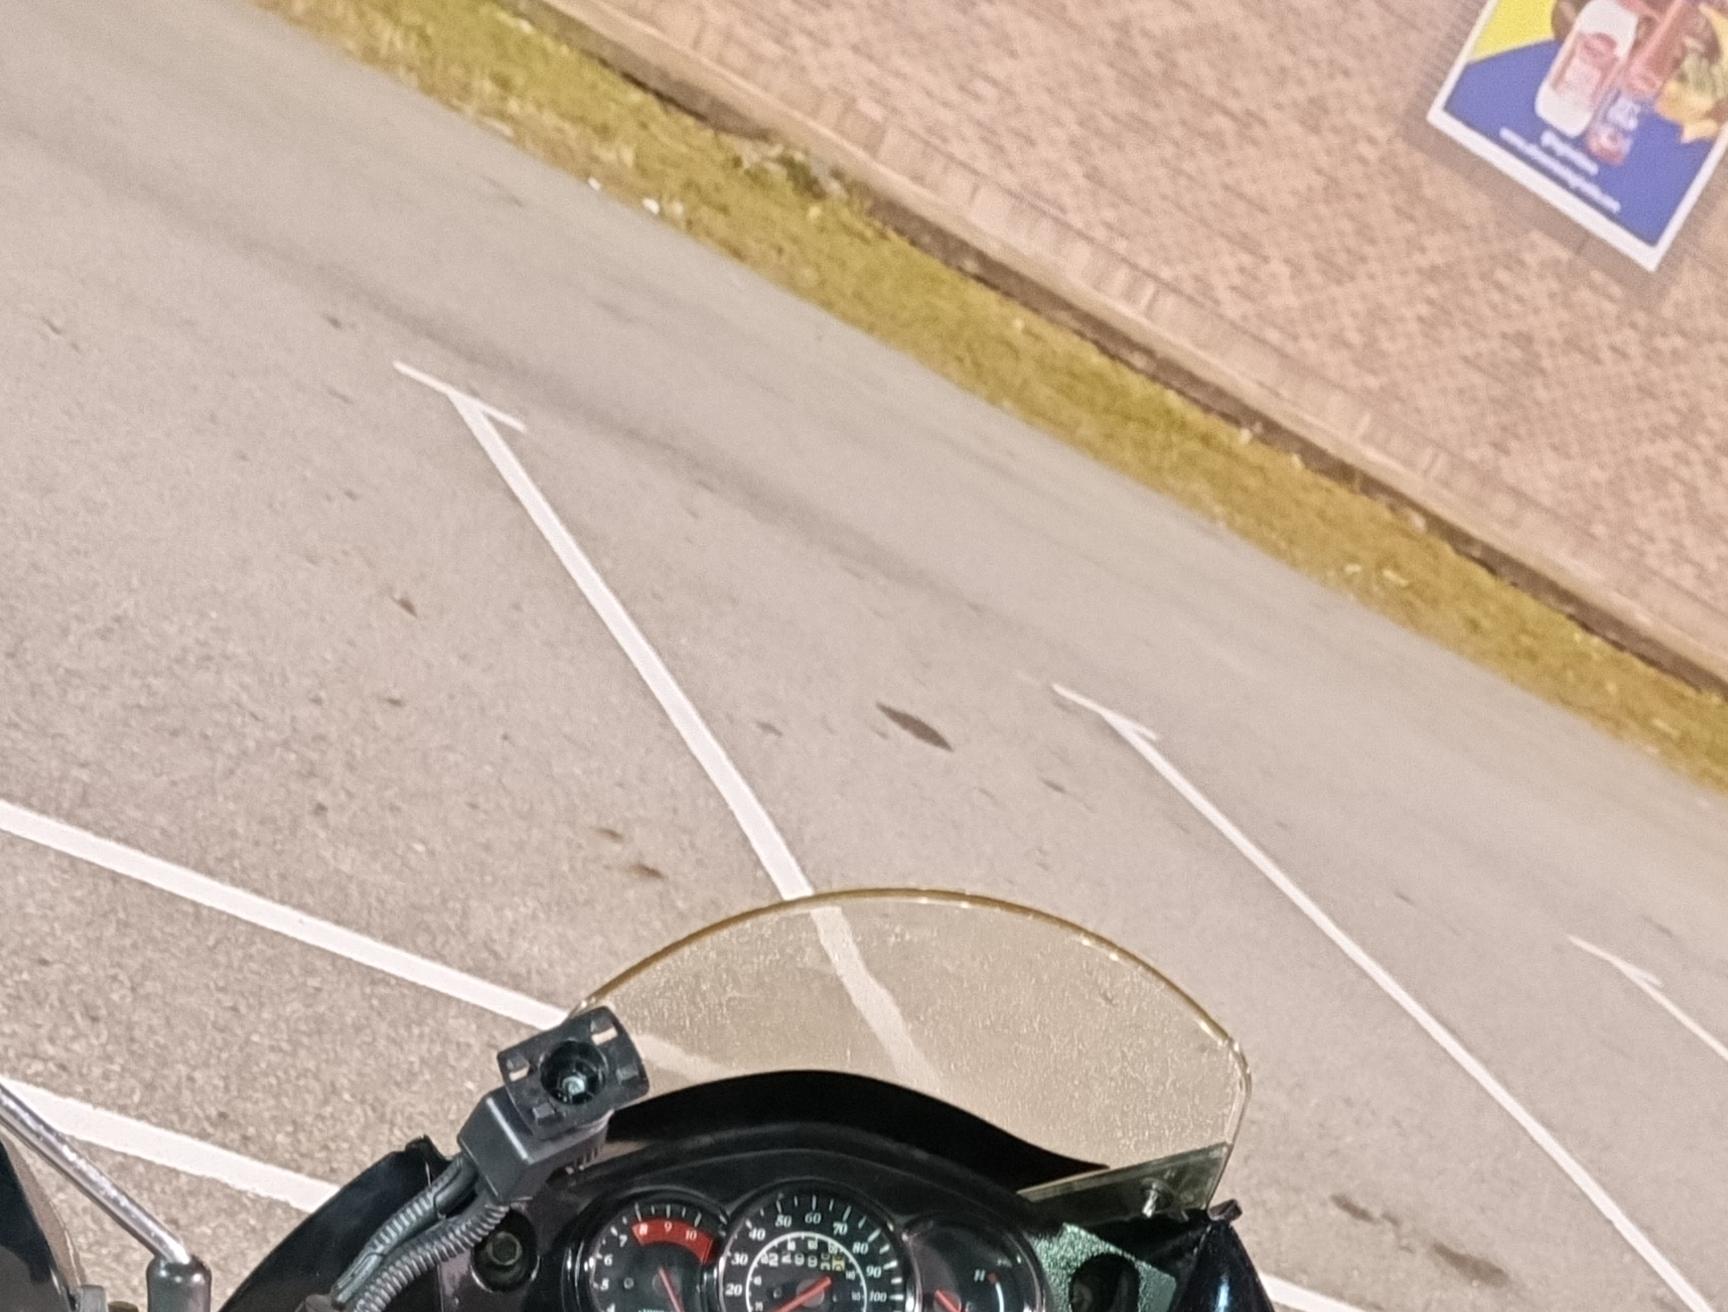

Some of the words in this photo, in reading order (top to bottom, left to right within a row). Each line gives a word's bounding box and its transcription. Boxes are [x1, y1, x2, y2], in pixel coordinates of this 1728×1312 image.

[805, 1212, 821, 1225] 60
[664, 1222, 672, 1232] 9
[832, 1222, 848, 1236] 70
[619, 1234, 628, 1248] 7
[685, 1229, 697, 1240] 10
[749, 1228, 766, 1241] 40
[852, 1242, 869, 1255] 80
[604, 1255, 613, 1266] 6
[731, 1253, 748, 1266] 30
[866, 1266, 882, 1279] 90
[601, 1279, 609, 1291] 5
[725, 1284, 743, 1296] 20
[869, 1291, 888, 1303] 100
